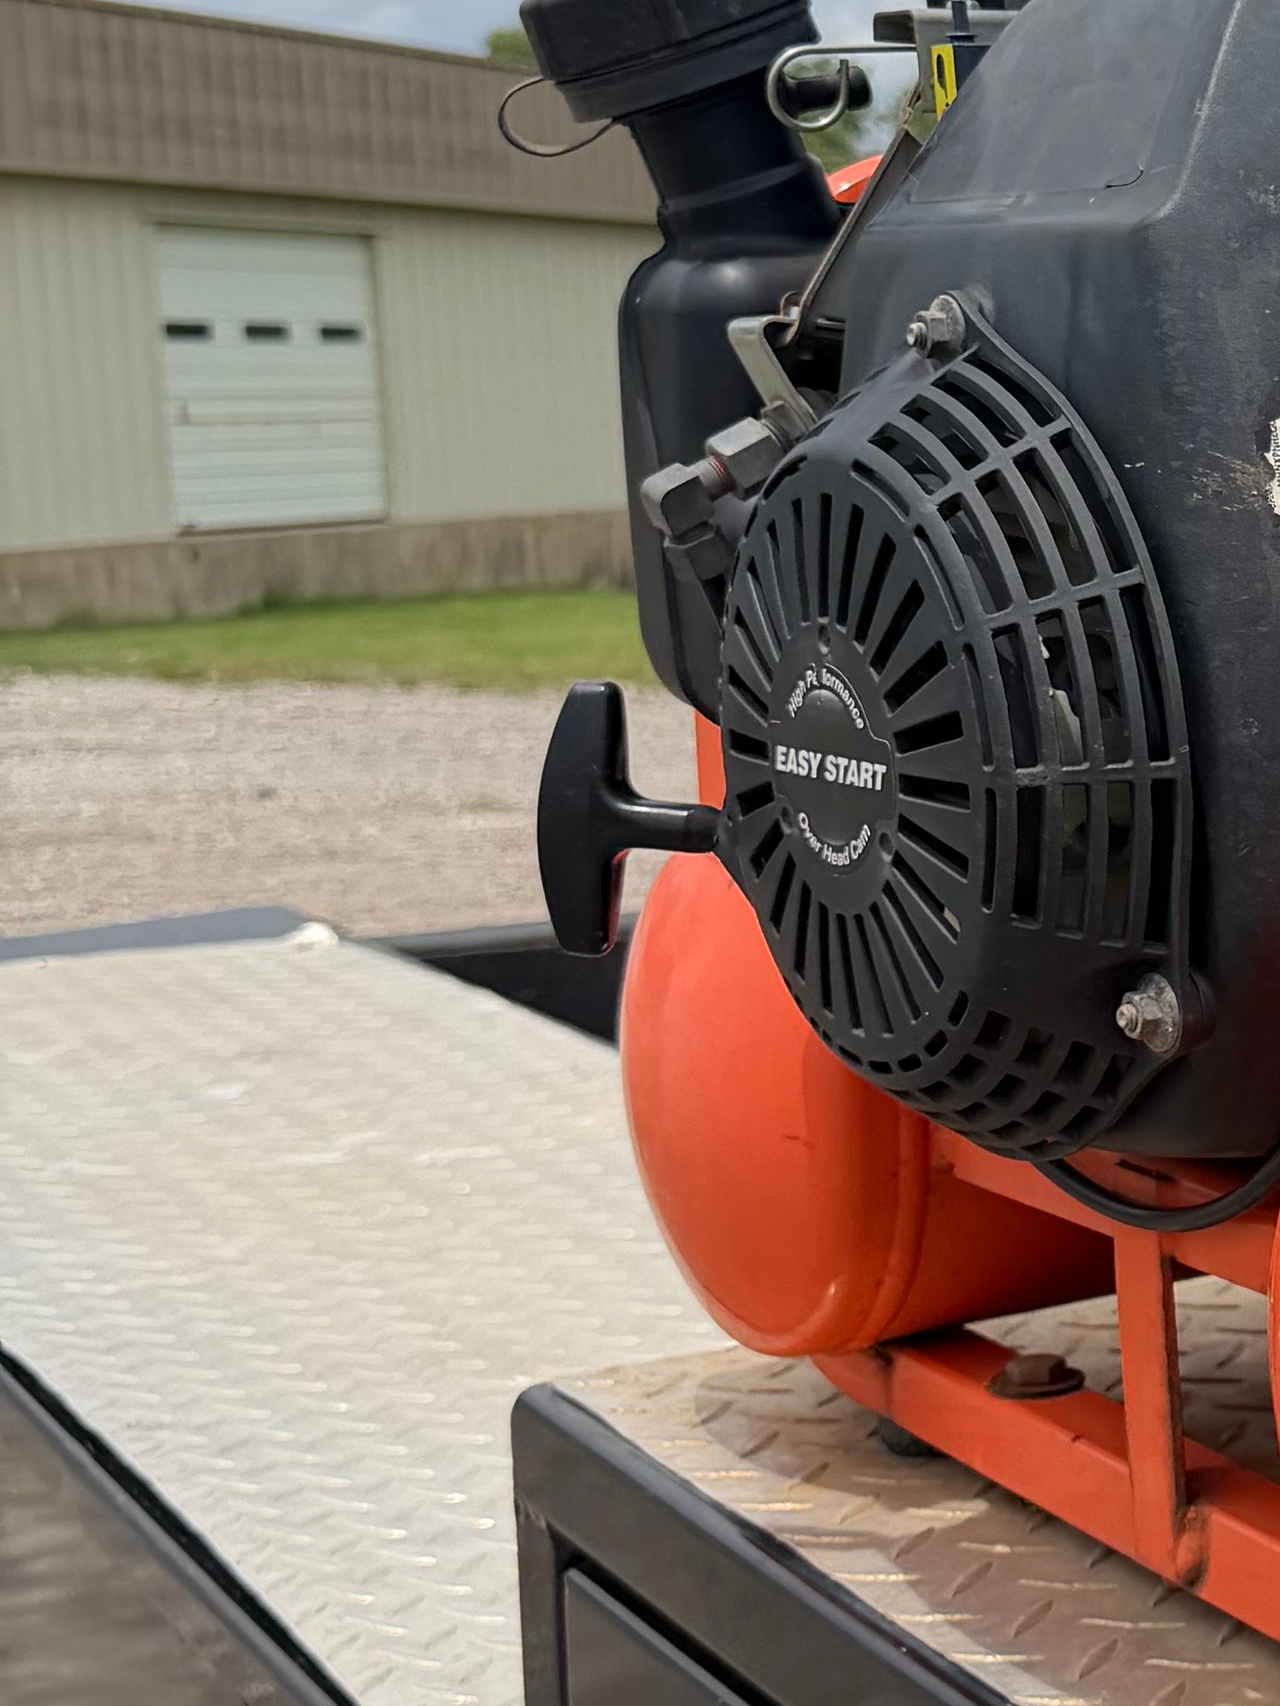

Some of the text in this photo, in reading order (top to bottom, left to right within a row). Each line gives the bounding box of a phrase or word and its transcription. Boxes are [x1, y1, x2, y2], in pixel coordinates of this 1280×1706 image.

[787, 679, 808, 718] High
[775, 744, 887, 791] EASY START
[798, 812, 872, 867] Over Head Cam
